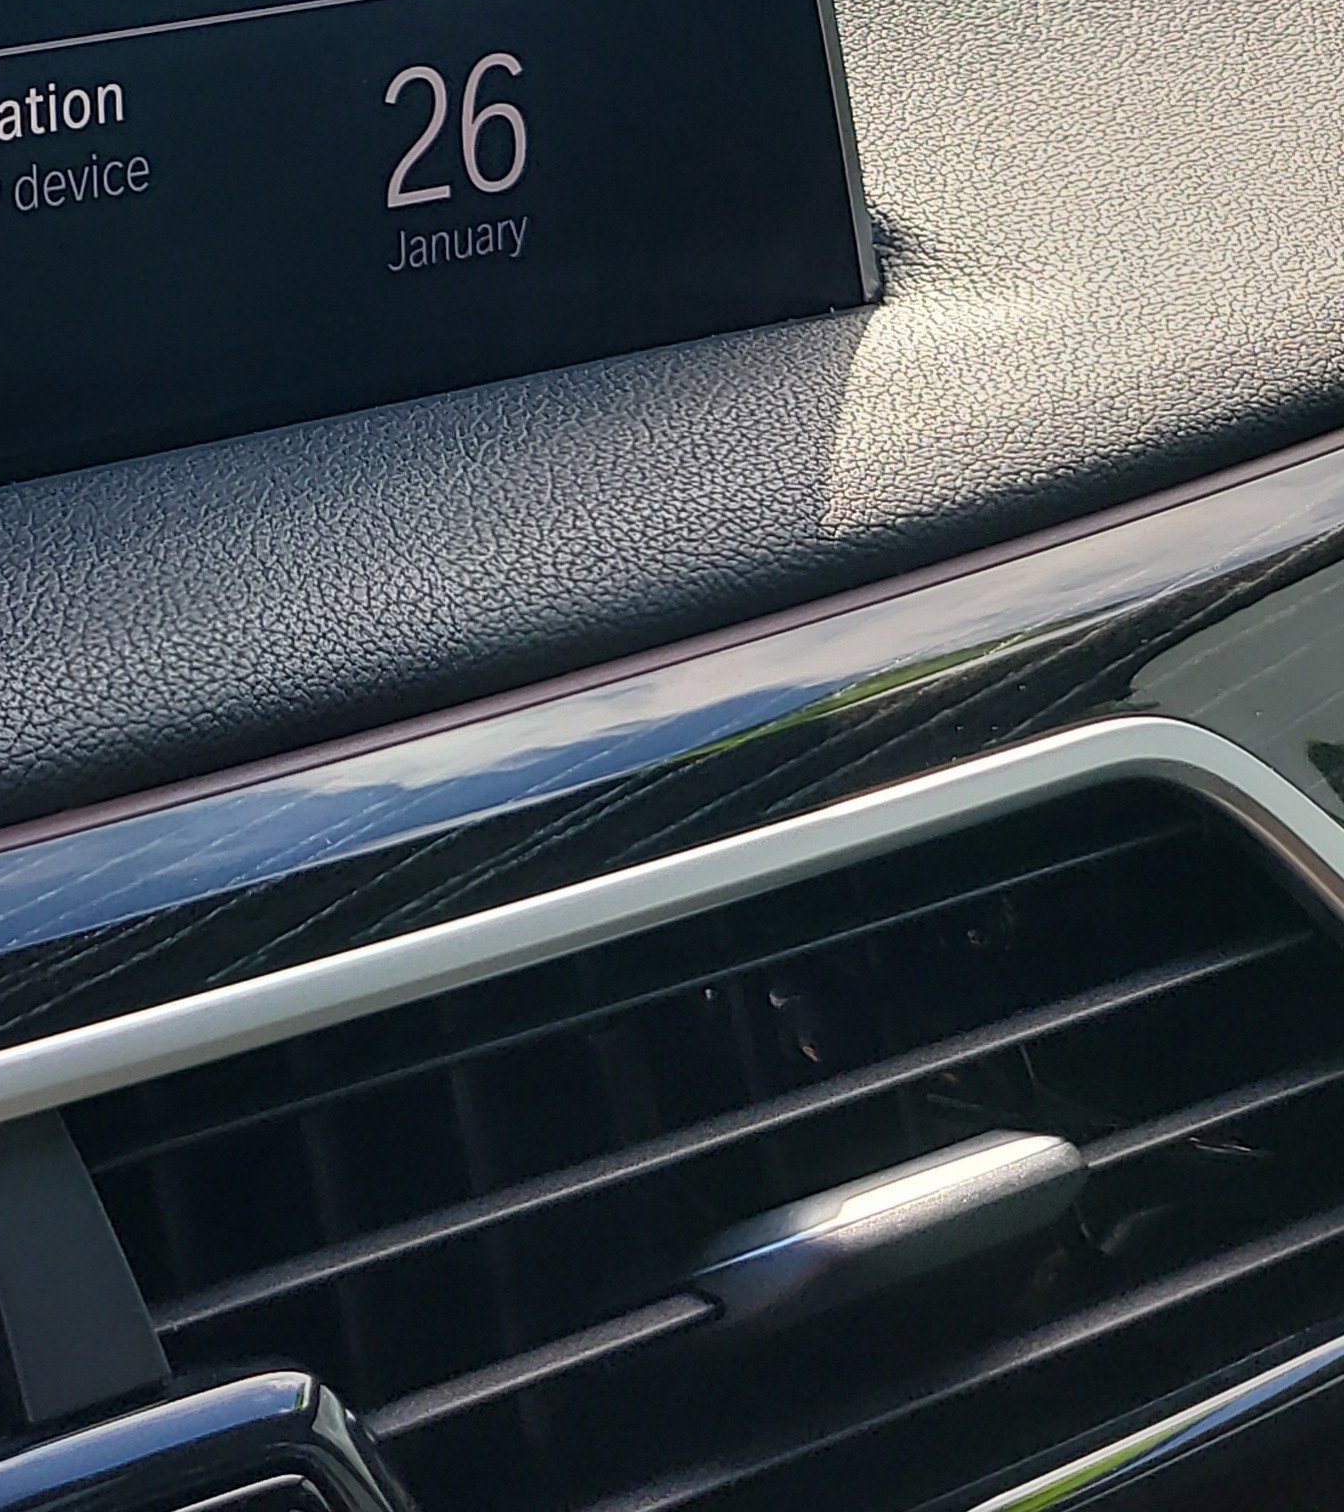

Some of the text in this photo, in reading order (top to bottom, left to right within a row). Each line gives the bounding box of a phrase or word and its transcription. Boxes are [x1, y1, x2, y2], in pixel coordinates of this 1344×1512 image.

[384, 52, 528, 209] 26
[14, 151, 150, 212] device
[386, 214, 528, 273] January
